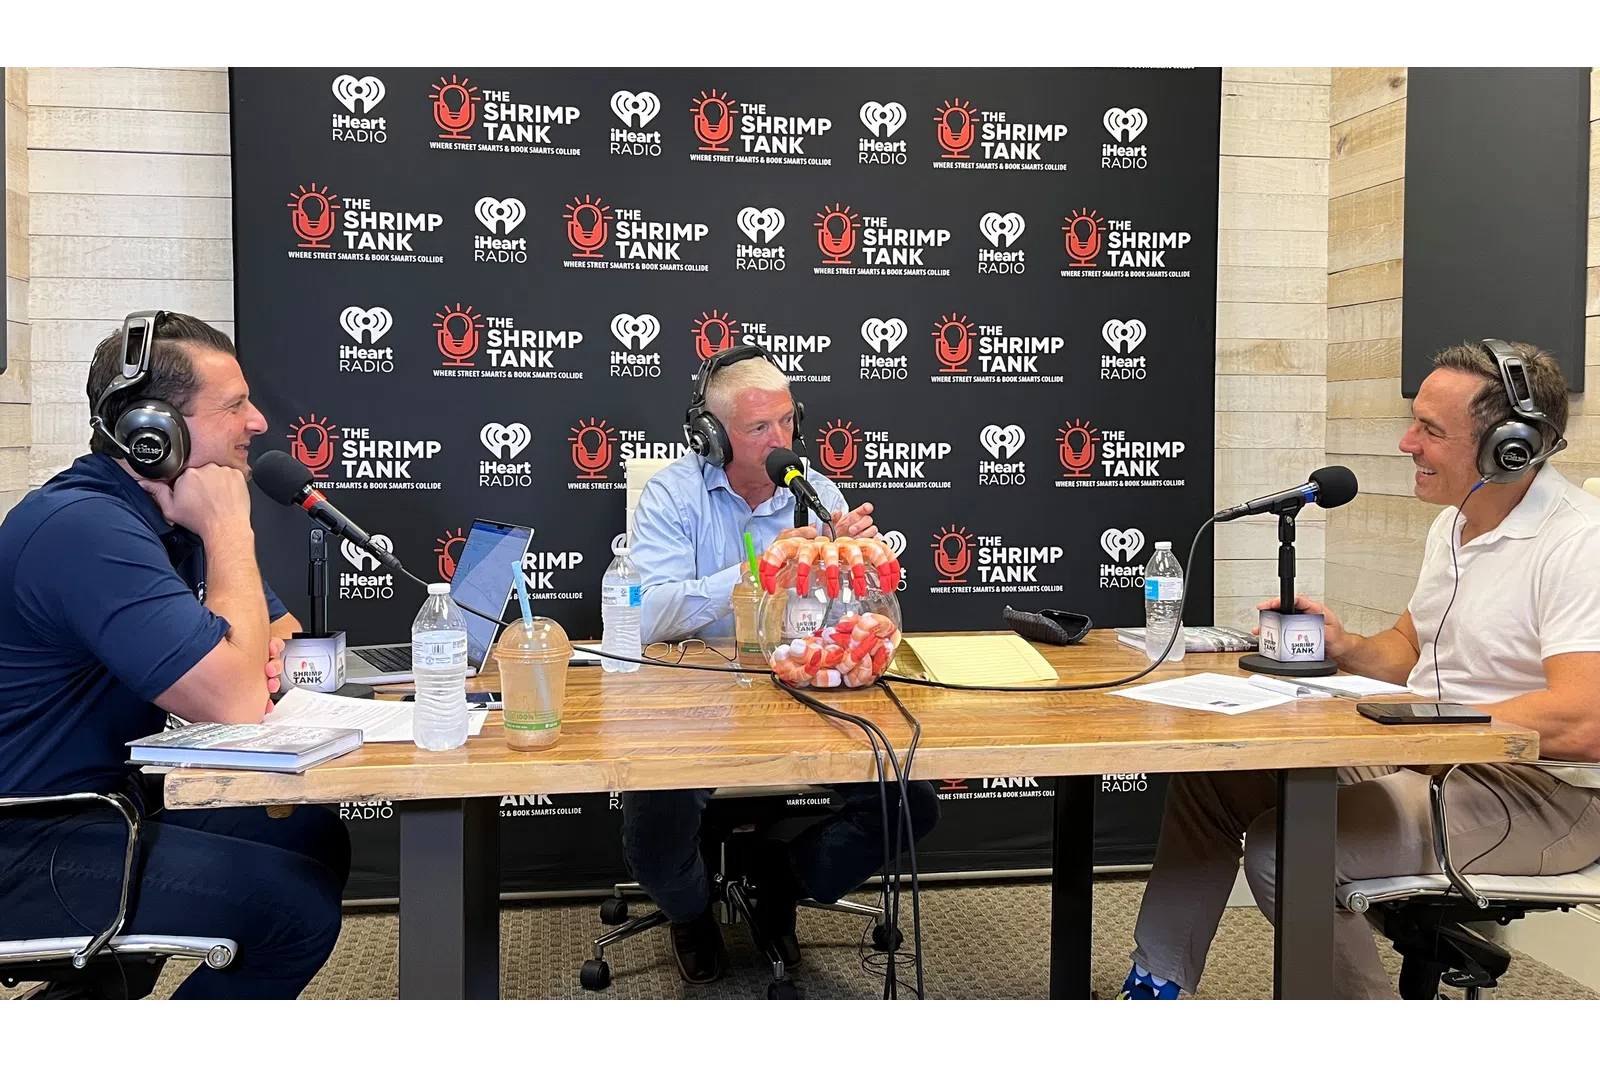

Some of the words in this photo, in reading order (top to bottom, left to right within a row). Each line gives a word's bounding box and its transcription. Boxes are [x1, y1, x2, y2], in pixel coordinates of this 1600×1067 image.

[483, 90, 510, 102] THE
[484, 103, 580, 124] SHRIMP
[741, 103, 766, 114] THE
[333, 114, 386, 130] iHeart
[982, 112, 1006, 122] THE
[741, 115, 832, 135] SHRIMP
[982, 123, 1068, 141] SHRIMP
[333, 129, 387, 143] RADIO
[484, 123, 551, 143] TANK
[611, 128, 661, 143] iHeart
[454, 143, 477, 151] STREET
[478, 144, 503, 152] SMARTS
[529, 146, 554, 154] SMARTS
[555, 148, 580, 156] COLLIDE
[611, 142, 661, 156] RADIO
[741, 135, 804, 154] TANK
[860, 137, 907, 152] iHeart
[981, 142, 1041, 160] TANK
[1103, 143, 1147, 156] iHeart
[859, 152, 907, 164] RADIO
[1102, 157, 1147, 168] RADIO
[343, 198, 370, 209] THE
[343, 210, 443, 231] SHRIMP
[615, 209, 641, 220] THE
[863, 217, 887, 227] THE
[1108, 220, 1131, 230] THE
[616, 221, 708, 241] SHRIMP
[863, 228, 950, 246] SHRIMP
[344, 231, 413, 251] TANK
[475, 235, 526, 250] iHeart
[1108, 231, 1191, 249] SHRIMP
[288, 251, 312, 259] WHERE
[390, 254, 416, 262] SMARTS
[417, 255, 443, 263] COLLIDE
[475, 250, 527, 263] RADIO
[616, 241, 680, 260] TANK
[737, 244, 785, 258] iHeart
[862, 248, 924, 265] TANK
[979, 249, 1025, 262] iHeart
[737, 258, 786, 270] RADIO
[1108, 251, 1165, 267] TANK
[979, 262, 1025, 274] RADIO
[486, 317, 514, 328] THE
[741, 323, 766, 333] THE
[979, 325, 1002, 335] THE
[487, 329, 583, 348] SHRIMP
[742, 334, 831, 353] SHRIMP
[979, 337, 1064, 354] SHRIMP
[340, 344, 393, 360] iHeart
[487, 349, 554, 368] TANK
[611, 350, 660, 364] iHeart
[340, 360, 394, 373] RADIO
[861, 354, 907, 367] iHeart
[978, 356, 1038, 372] TANK
[1102, 355, 1146, 367] iHeart
[611, 365, 661, 377] RADIO
[861, 368, 908, 379] RADIO
[1102, 368, 1146, 379] RADIO
[341, 428, 370, 439] THE
[619, 430, 645, 440] THE
[864, 432, 888, 441] THE
[1102, 431, 1125, 440] THE
[342, 440, 441, 458] SHRIMP
[620, 442, 691, 459] SHRIM
[865, 443, 951, 460] SHRIMP
[1102, 442, 1185, 458] SHRIMP
[341, 460, 411, 478] TANK
[480, 460, 531, 474] iHeart
[864, 462, 924, 478] TANK
[980, 461, 1025, 473] iHeart
[1102, 460, 1159, 476] TANK
[480, 474, 532, 487] RADIO
[980, 474, 1026, 485] RADIO
[978, 536, 1002, 546] THE
[522, 552, 583, 570] RIMP
[978, 547, 1063, 564] SHRIMP
[978, 566, 1037, 582] TANK
[1100, 564, 1145, 576] iHeart
[340, 572, 393, 586] iHeart
[522, 571, 554, 589] NK
[1100, 577, 1145, 588] RADIO
[340, 587, 394, 599] RADIO
[1102, 780, 1147, 792] RADIO
[340, 807, 393, 820] RADIO
[531, 808, 556, 816] SMARTS
